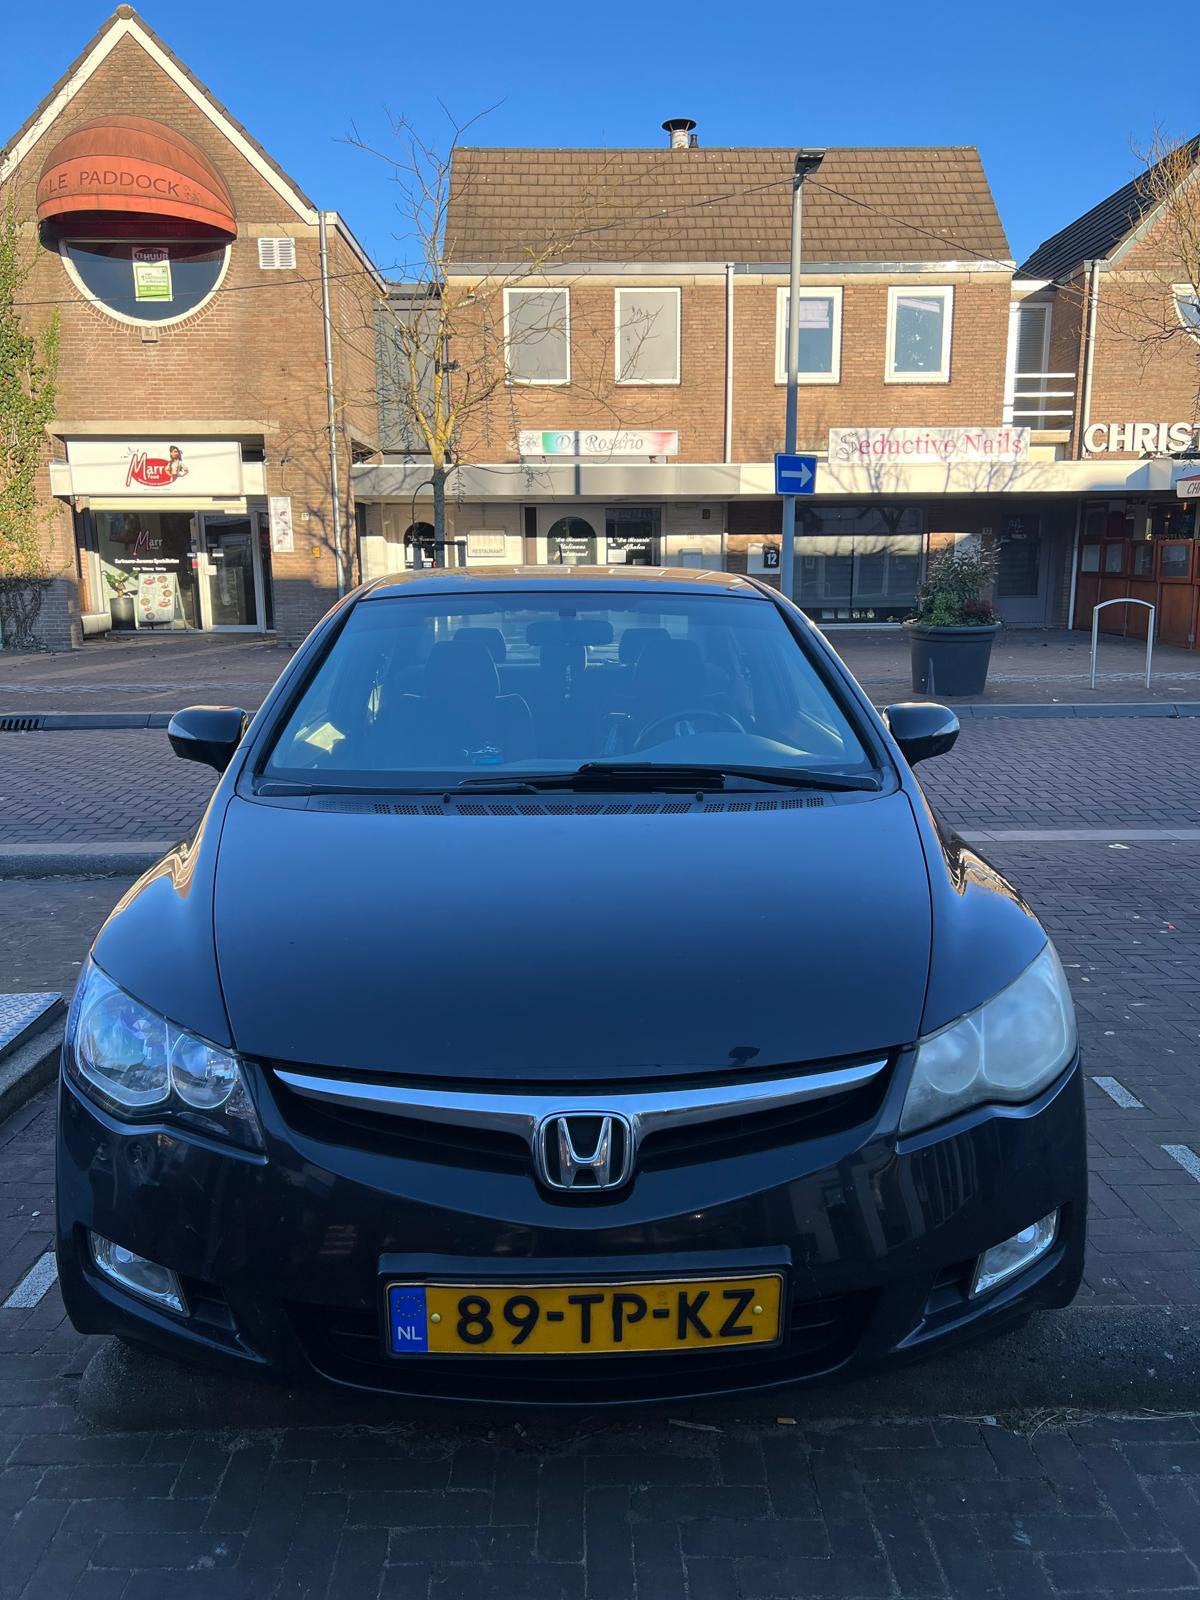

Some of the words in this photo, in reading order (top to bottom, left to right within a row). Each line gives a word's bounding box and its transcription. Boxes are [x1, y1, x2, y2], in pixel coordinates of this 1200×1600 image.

[49, 173, 69, 193] LE
[79, 170, 180, 198] PADDOCK
[143, 253, 169, 261] HUUR
[836, 432, 958, 461] Seductive
[964, 432, 1023, 454] Nails
[126, 452, 165, 487] Marr
[1187, 481, 1200, 495] CH
[767, 553, 777, 565] 12
[456, 1288, 756, 1345] 89-TP-KZ
[397, 1326, 423, 1341] NL
